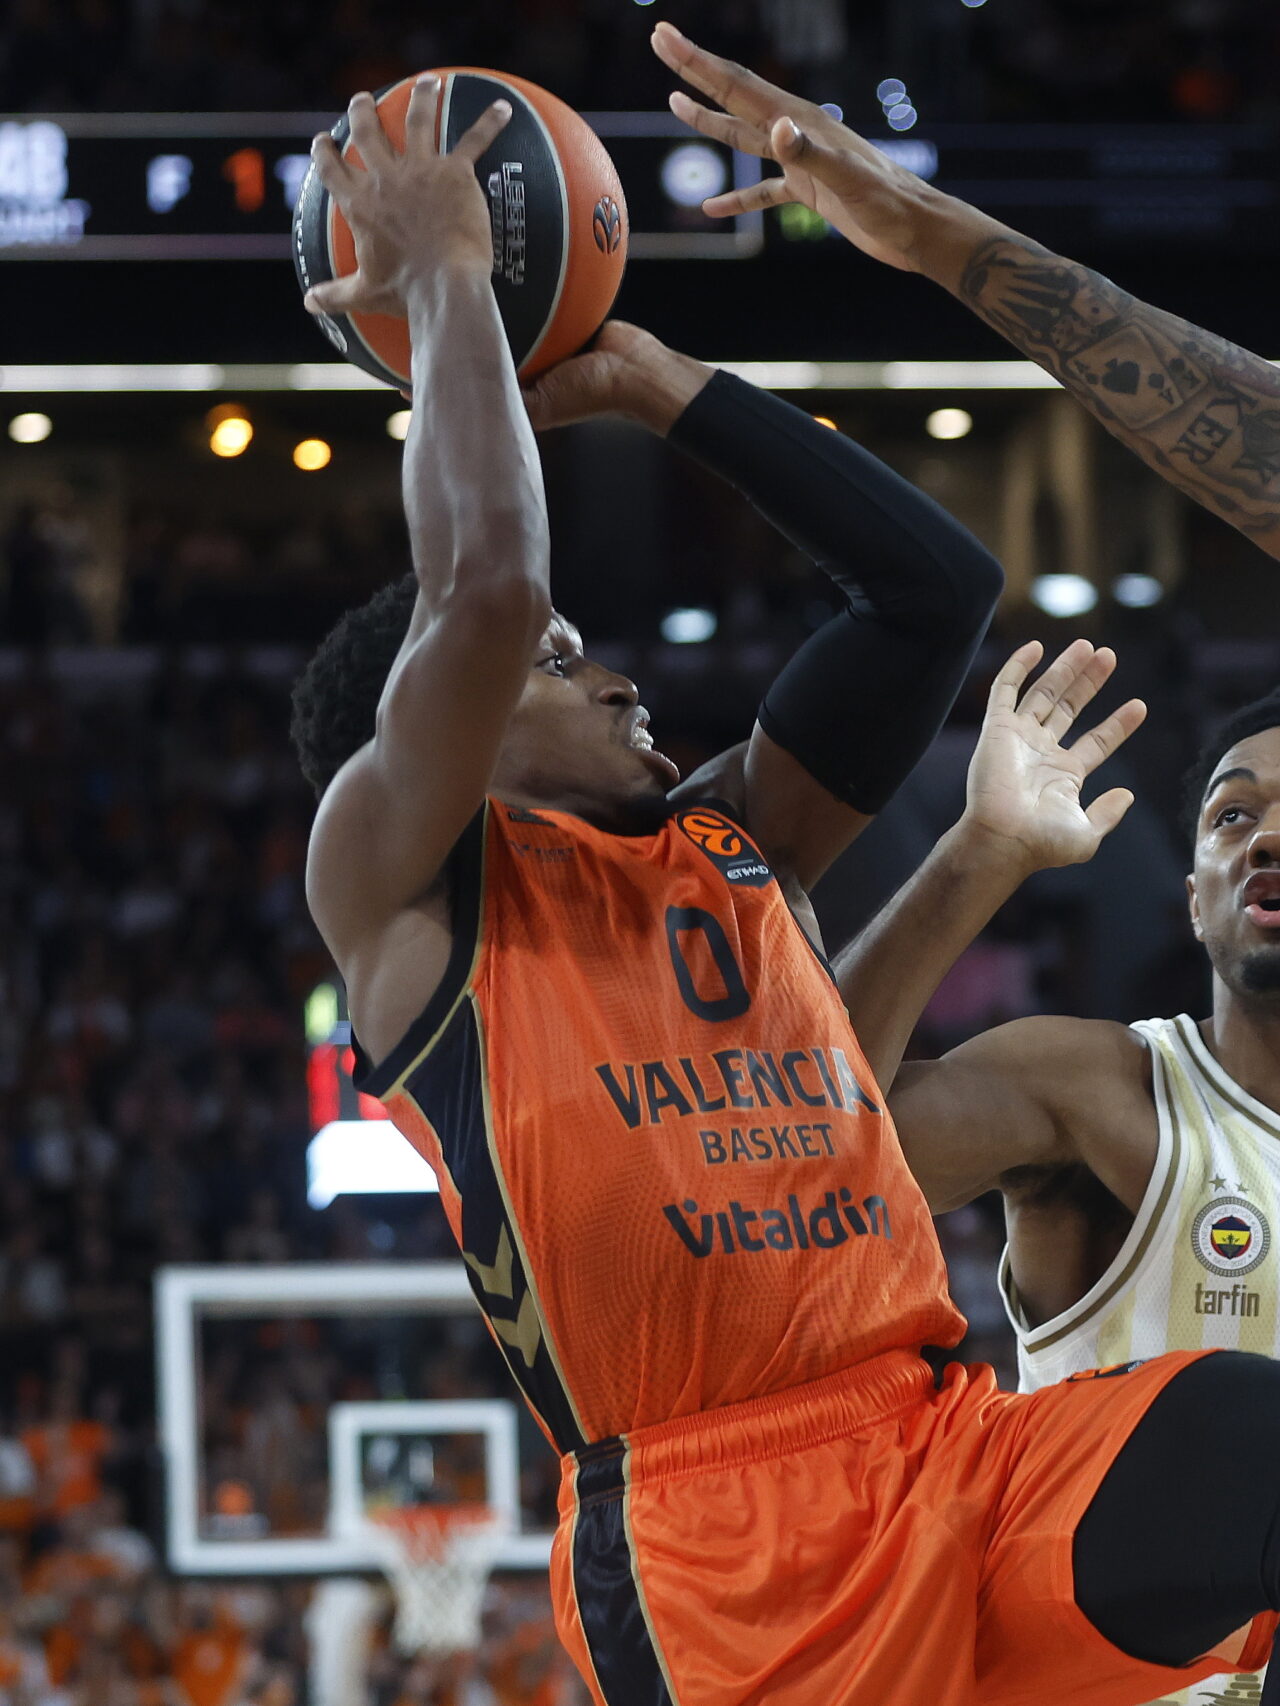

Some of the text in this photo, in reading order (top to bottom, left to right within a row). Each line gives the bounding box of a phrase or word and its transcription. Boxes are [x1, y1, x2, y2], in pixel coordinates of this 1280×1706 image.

[502, 161, 525, 285] LEGACY
[665, 905, 751, 1023] 0
[595, 1046, 883, 1130] VALENCIA
[699, 1123, 837, 1167] BASKET
[662, 1187, 893, 1259] Vitaldin
[1195, 1282, 1261, 1317] tarfin
